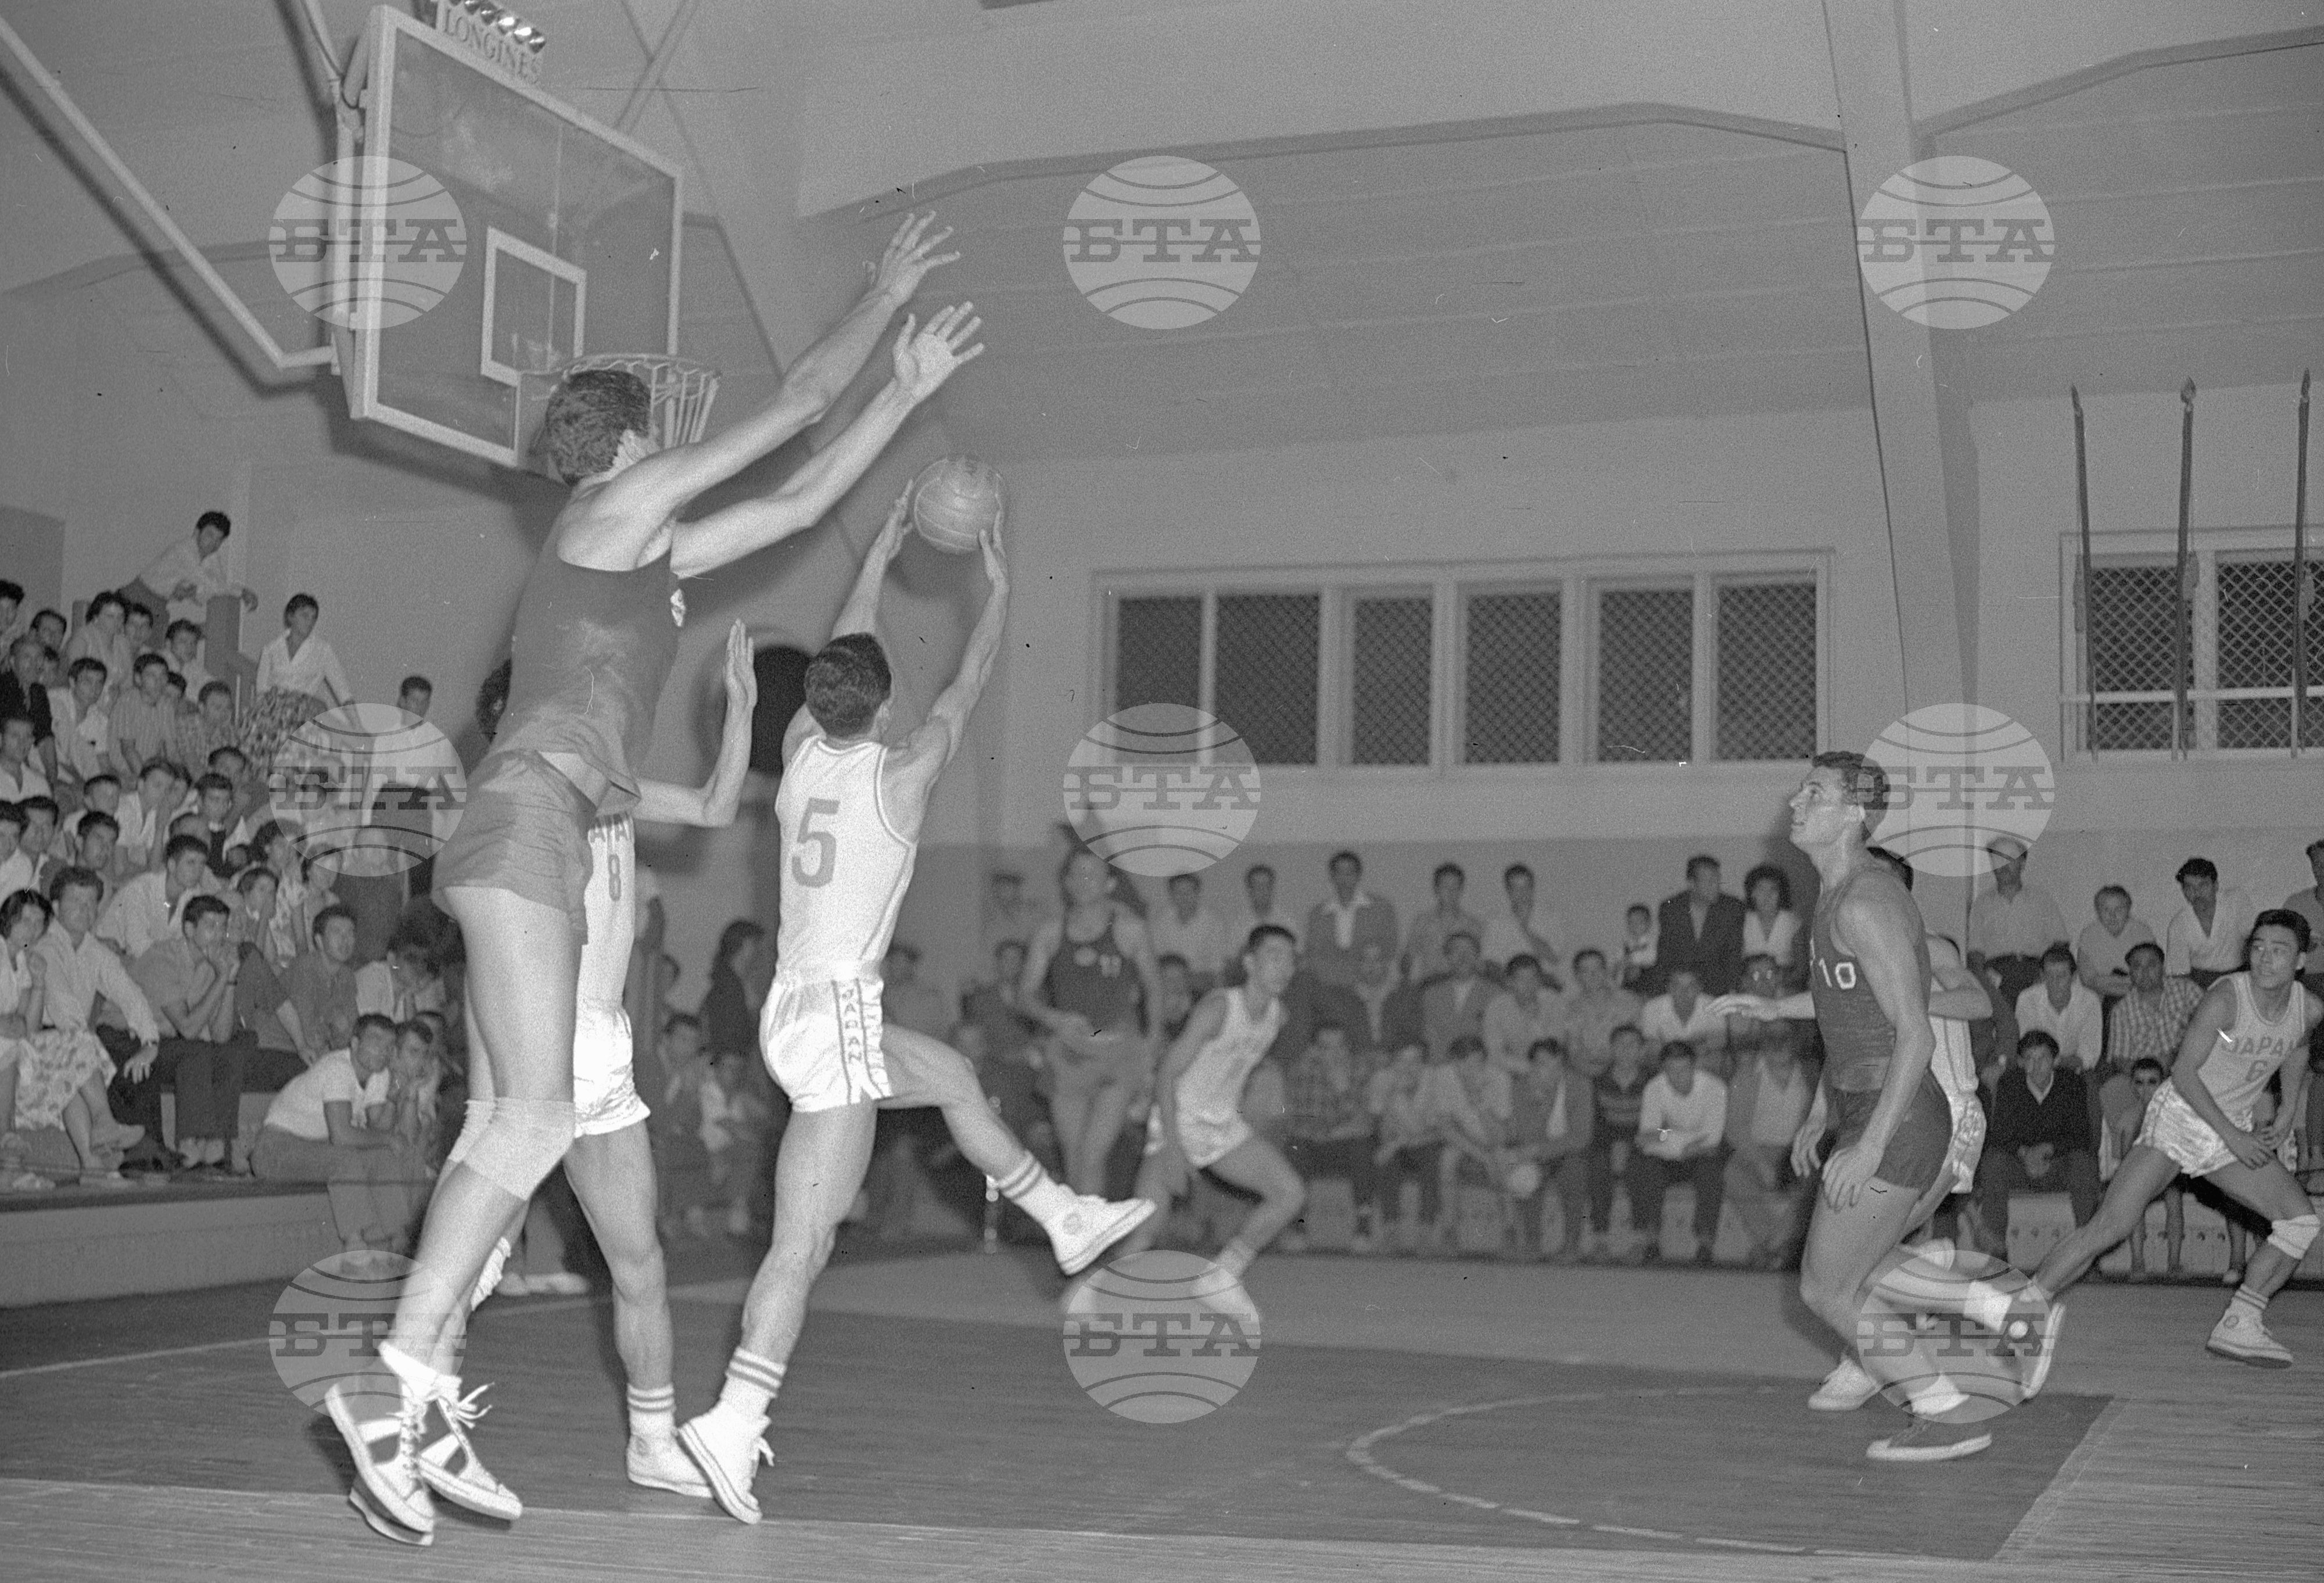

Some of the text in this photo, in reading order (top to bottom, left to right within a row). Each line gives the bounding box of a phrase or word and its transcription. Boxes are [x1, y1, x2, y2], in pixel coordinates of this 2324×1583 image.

[444, 8, 539, 85] LONGINES
[608, 853, 622, 901] 8
[792, 797, 840, 888] 5
[1819, 958, 1856, 989] 10
[842, 989, 863, 1064] JAPAN
